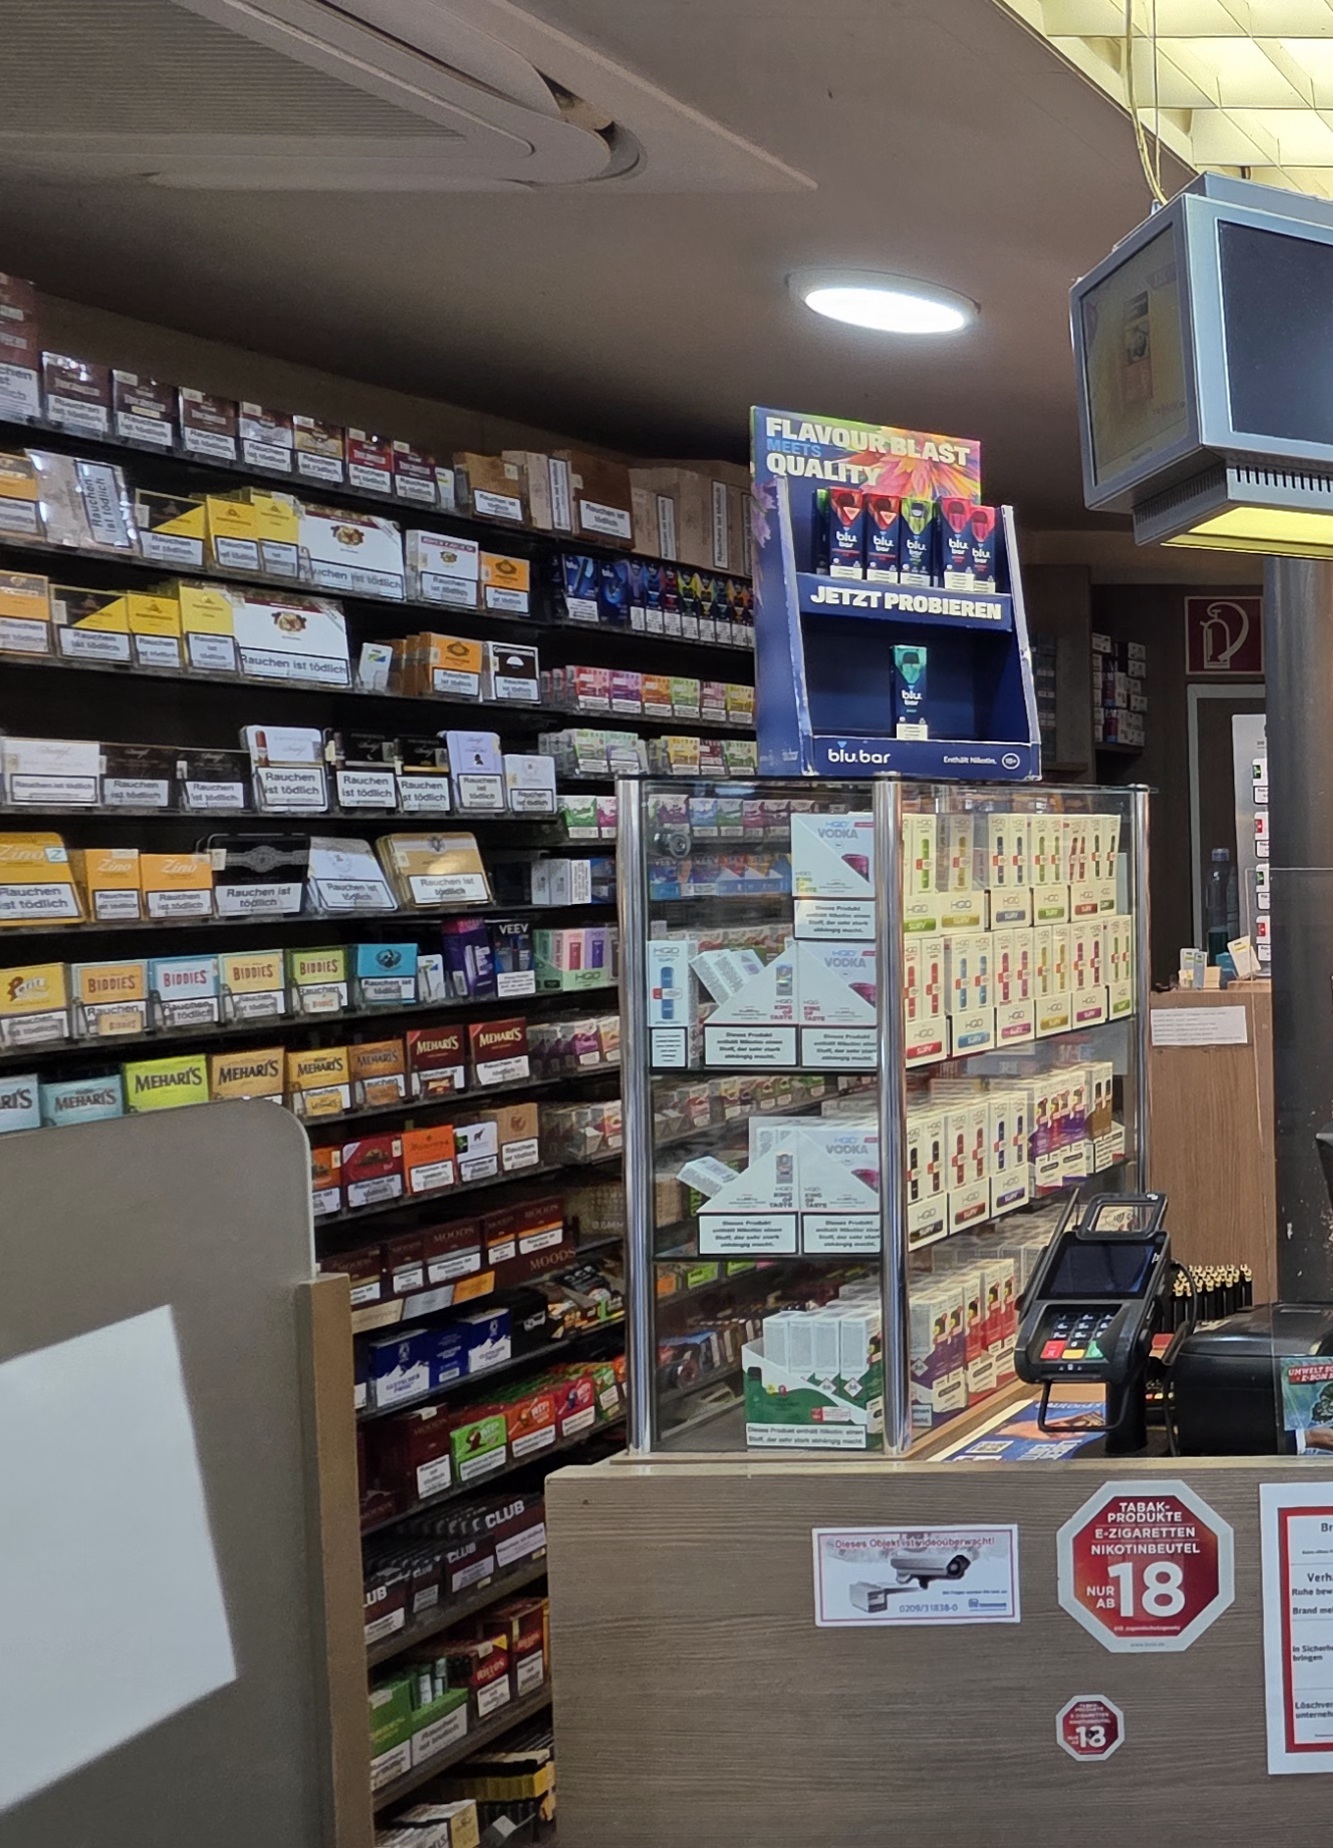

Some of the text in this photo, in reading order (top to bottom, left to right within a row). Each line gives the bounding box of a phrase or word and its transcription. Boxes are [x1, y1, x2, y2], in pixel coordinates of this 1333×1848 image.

[766, 416, 971, 466] FLAVOUR BLAST
[767, 438, 822, 457] MEETS
[766, 453, 883, 486] QUALITY
[810, 585, 1002, 620] JETZT PROBIEREN
[265, 772, 315, 783] Rauchen
[344, 776, 389, 785] Rauchen
[402, 781, 443, 790] Rauchen
[342, 788, 392, 798] ist tödlich
[818, 828, 859, 839] VODKA
[98, 858, 132, 872] Zino
[162, 859, 197, 873] Zino
[227, 887, 292, 898] Rauchen ist
[499, 923, 529, 935] VEEV
[300, 959, 338, 975] BIDDIES
[825, 958, 866, 968] VODKA
[163, 970, 207, 987] BIDDIES
[233, 964, 274, 981] BIDDIES
[87, 974, 136, 994] BIDDIES
[479, 1027, 522, 1047] MEHARI'S
[416, 1035, 460, 1054] MEHARI'S
[217, 1060, 279, 1084] MEHARI'S
[297, 1057, 343, 1076] MEHARI'S
[135, 1064, 203, 1093] MEHARI'S
[825, 1144, 869, 1155] VODKA
[1288, 1365, 1324, 1376] UMWELT
[1301, 1372, 1327, 1382] E-BON
[1119, 1501, 1170, 1513] TABAK-
[485, 1499, 525, 1528] CLUB
[1107, 1512, 1182, 1523] PRODUKTE
[1095, 1527, 1196, 1539] E-ZIGARETTEN
[835, 1540, 867, 1549] Dieses
[871, 1538, 900, 1549] Objekt
[917, 1537, 995, 1548] videoüberwacht!
[1091, 1543, 1201, 1555] NIKOTINBEUTEL
[446, 1542, 477, 1564] CLUB
[1087, 1586, 1115, 1596] NUR
[1107, 1561, 1186, 1617] 18
[1292, 1588, 1314, 1596] Ruhe
[1096, 1598, 1115, 1609] AB
[1293, 1607, 1317, 1615] Brand
